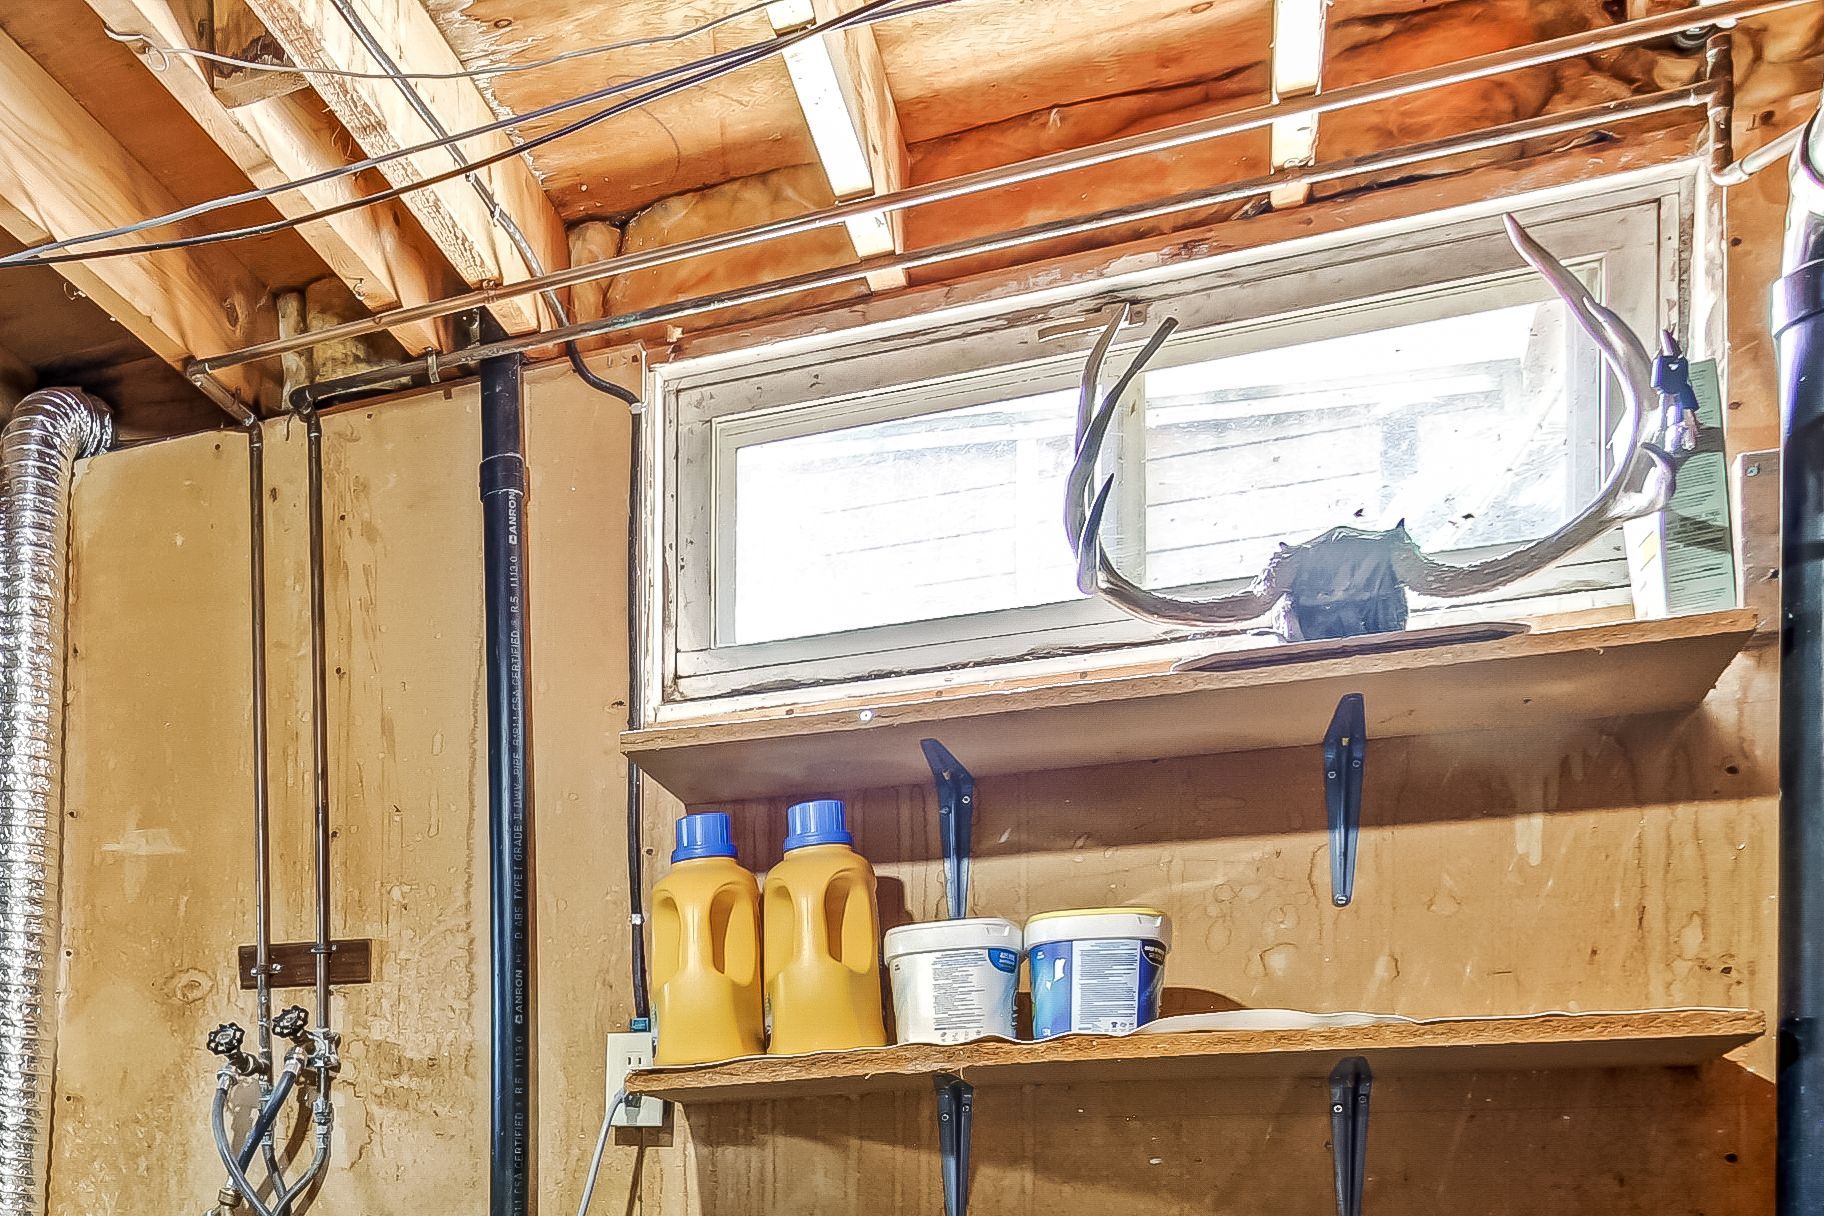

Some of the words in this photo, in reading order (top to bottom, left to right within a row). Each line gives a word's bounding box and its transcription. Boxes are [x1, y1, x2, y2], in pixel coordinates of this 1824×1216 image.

[510, 630, 520, 686] CERTIFIED
[513, 825, 522, 861] GRADE
[514, 874, 523, 900] TYPE
[514, 1112, 523, 1169] CERTIFIED
